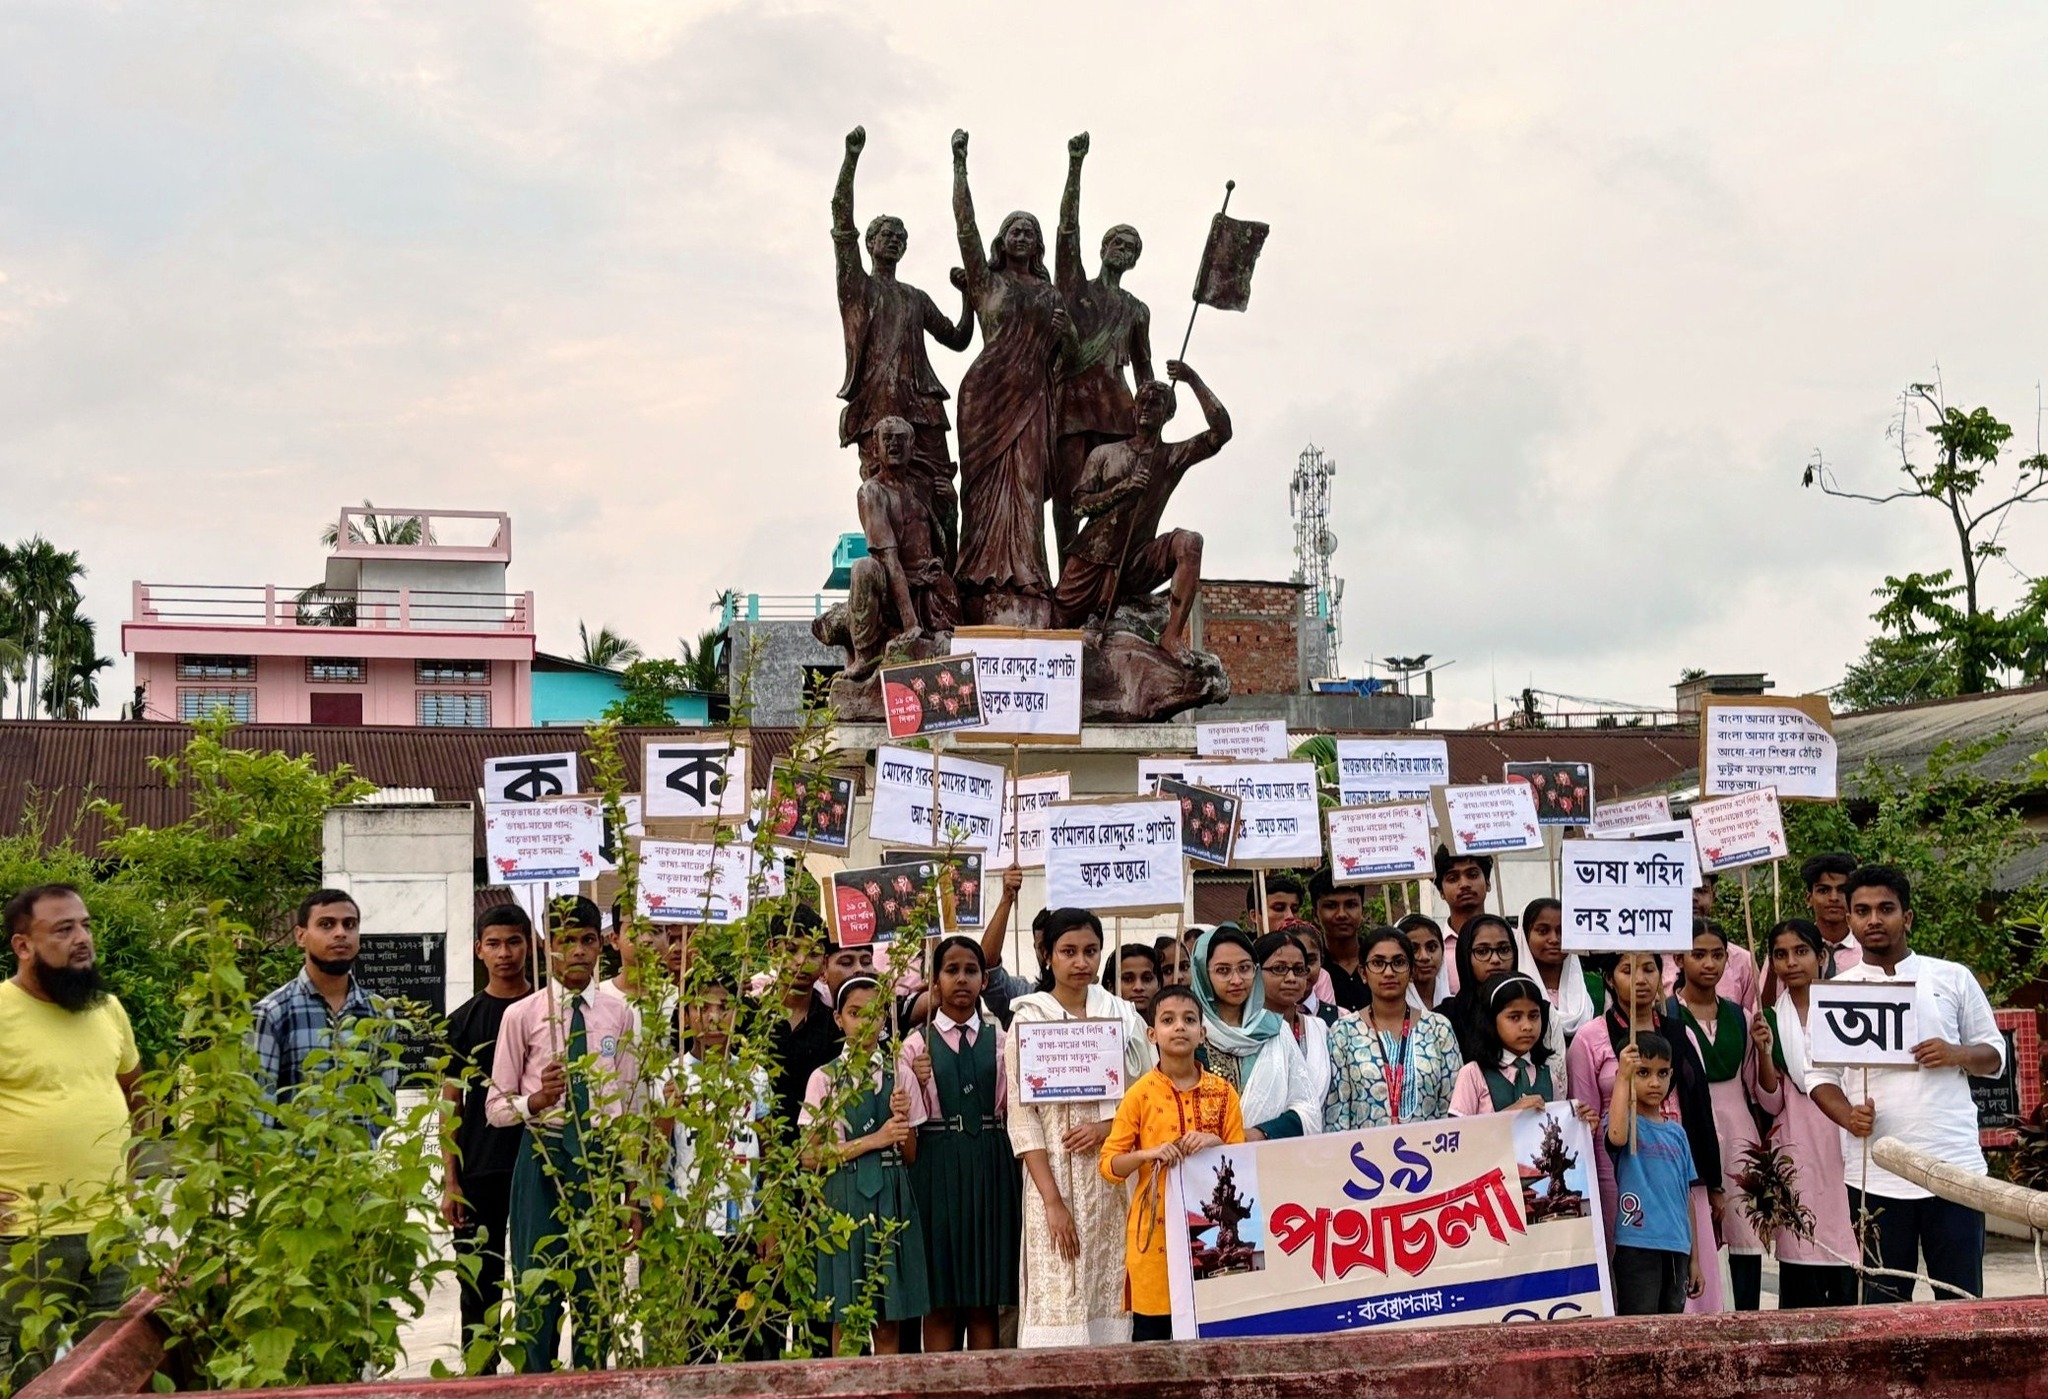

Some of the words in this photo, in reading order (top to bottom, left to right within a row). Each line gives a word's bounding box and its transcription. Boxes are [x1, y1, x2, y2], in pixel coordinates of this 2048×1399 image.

[1002, 657, 1037, 682] রোদ্দুরে
[1047, 653, 1076, 681] প্রাণটা
[982, 691, 1010, 715] জ্বলুক
[1013, 692, 1048, 711] অন্তরে।
[1718, 714, 1742, 724] বাংলা
[1745, 714, 1775, 724] আমার
[1777, 714, 1803, 726] মুখের
[1718, 731, 1742, 740] বাংলা
[1745, 731, 1774, 740] আমার
[1777, 731, 1804, 742] বুকের
[1768, 745, 1795, 757] শিশুর
[495, 759, 568, 801] ক
[658, 749, 734, 807] ক
[882, 761, 914, 785] মোদের
[938, 770, 967, 793] মোদের
[968, 775, 993, 800] আশা;
[1717, 763, 1742, 776] ফুটুক
[1239, 777, 1254, 799] লিখি
[1256, 783, 1271, 799] ভাষা
[1273, 783, 1295, 799] মায়ের
[969, 815, 993, 837] ভাষা।
[1050, 818, 1095, 846] বর্ণমালার
[1098, 823, 1135, 851] রোদ্দুরে
[1146, 815, 1176, 845] প্রাণটা
[1256, 818, 1276, 839] অমৃত
[1080, 862, 1111, 888] জ্বলুক
[1113, 860, 1150, 883] অন্তরে।
[1574, 860, 1628, 884] ভাষা
[1634, 853, 1684, 886] শহিদ
[1574, 908, 1611, 932] লহ
[1618, 908, 1673, 937] প্রণাম
[1032, 1028, 1069, 1039] মাতৃভাষার
[1086, 1024, 1103, 1034] লিখি
[1818, 1001, 1911, 1051] আ
[1036, 1054, 1068, 1063] মাতৃভাষা
[1268, 1167, 1528, 1283] পথচলা
[1357, 1291, 1444, 1322] ব্যবস্থাপনায়
